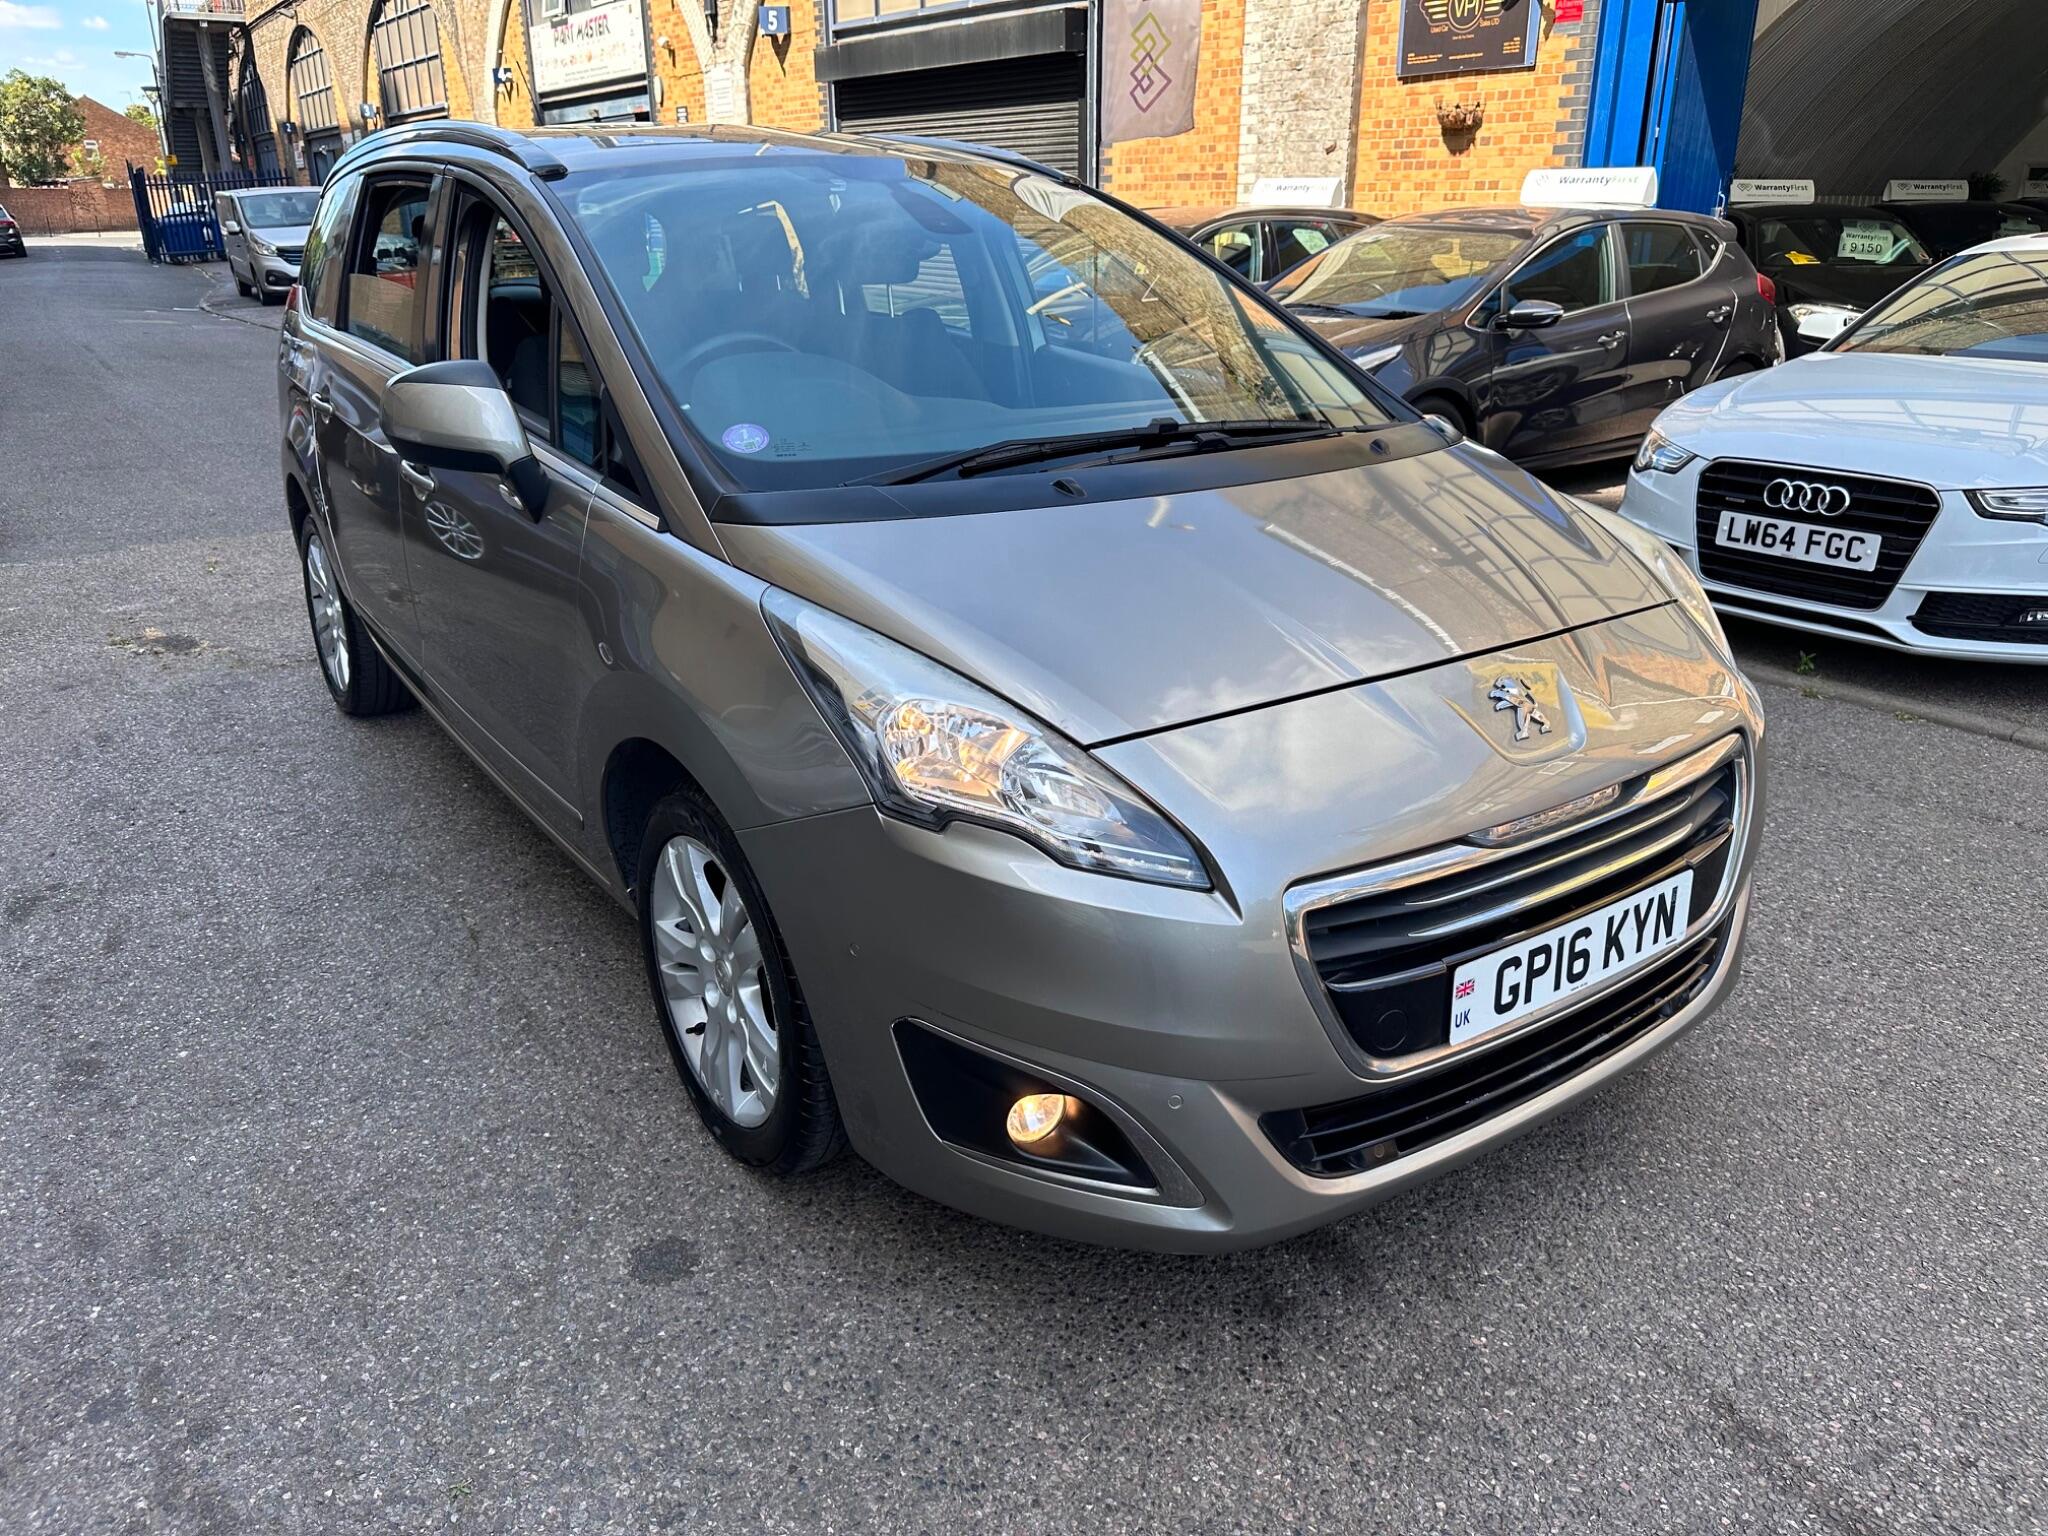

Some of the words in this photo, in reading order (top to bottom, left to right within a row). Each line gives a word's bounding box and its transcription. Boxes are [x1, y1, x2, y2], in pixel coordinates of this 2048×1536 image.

[767, 10, 778, 31] 5
[553, 23, 574, 47] PART
[576, 14, 611, 41] MASTER
[363, 105, 371, 117] 3
[1754, 184, 1809, 193] WarrantyFirst
[1913, 183, 1964, 192] WarrantyFirst
[1845, 231, 1889, 242] WarrantyFirst
[1850, 242, 1883, 254] 9150
[1726, 516, 1797, 552] LW64
[1804, 529, 1866, 563] FGC
[1493, 926, 1593, 1016] GP16
[1602, 886, 1679, 970] KYN
[1454, 1008, 1471, 1029] UK
